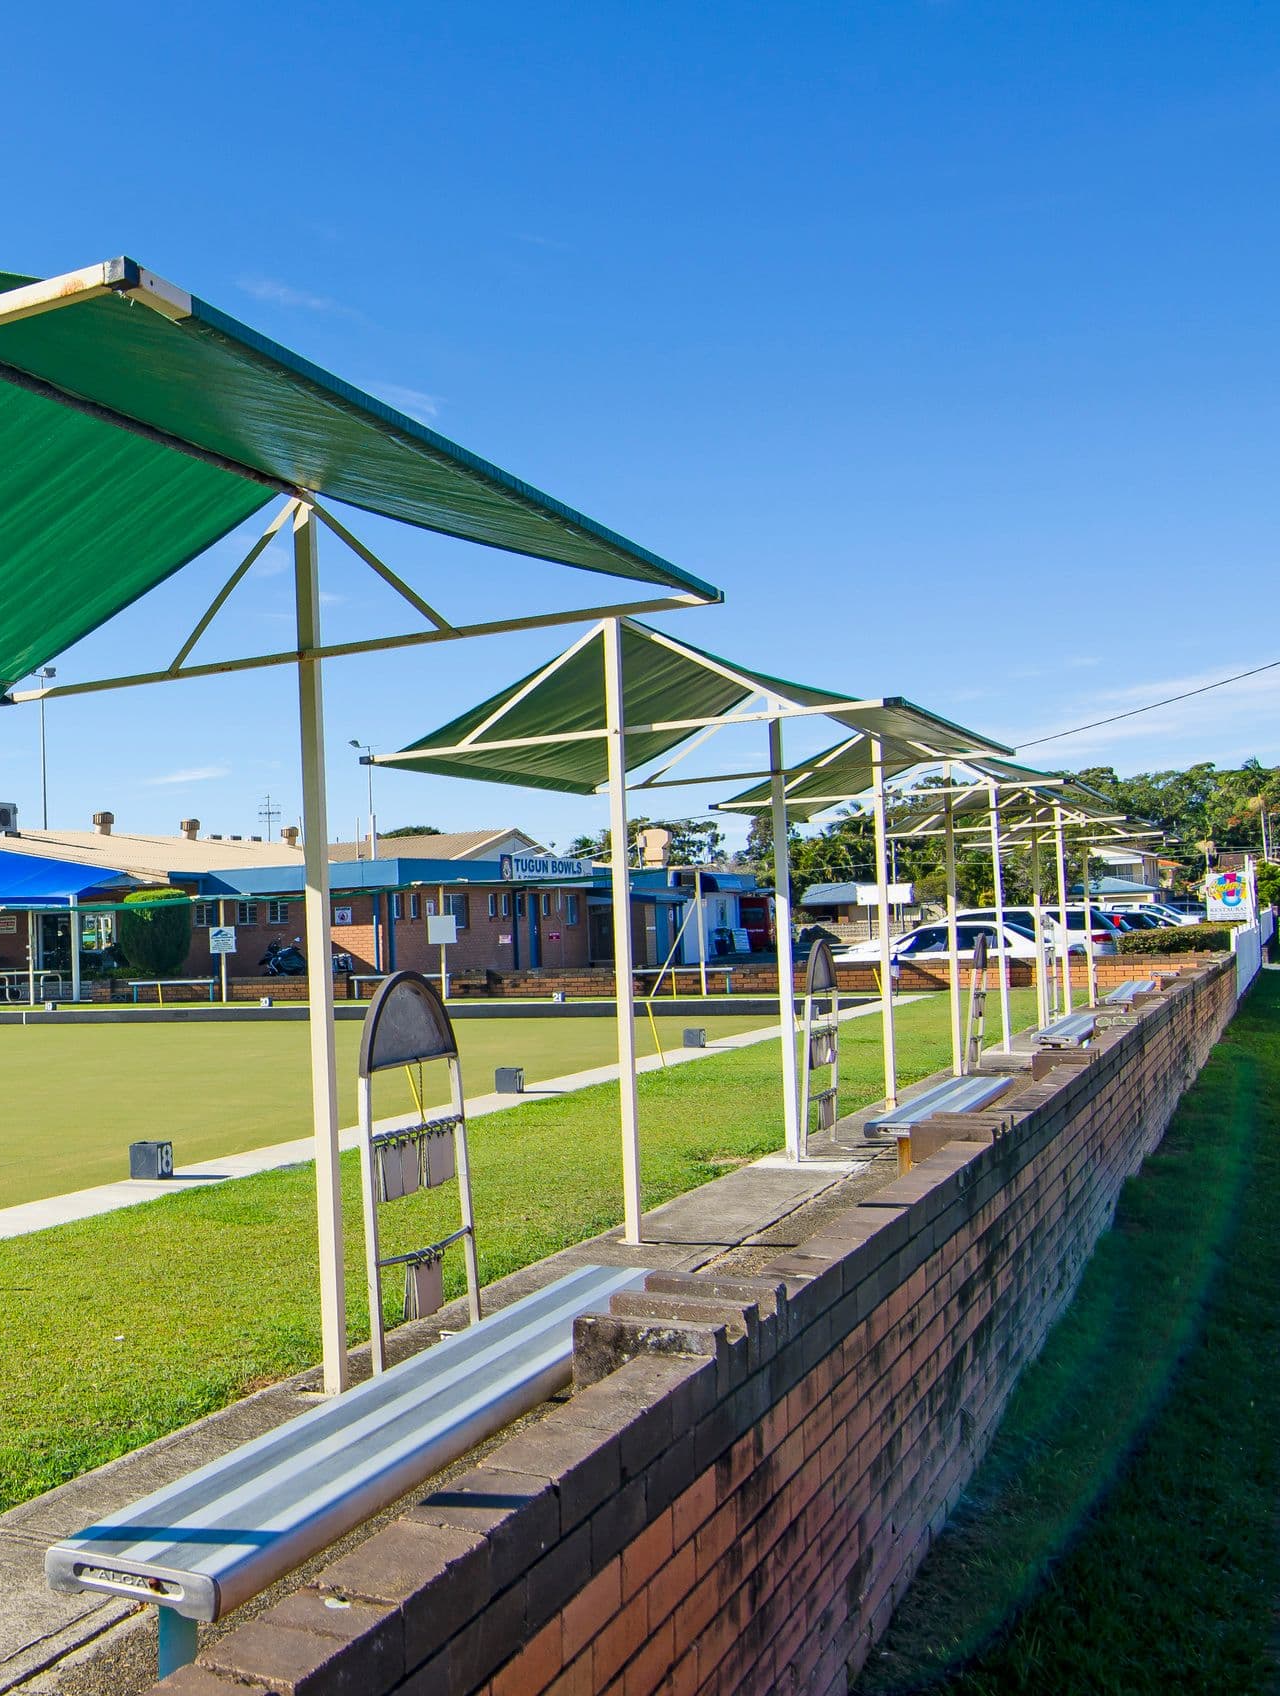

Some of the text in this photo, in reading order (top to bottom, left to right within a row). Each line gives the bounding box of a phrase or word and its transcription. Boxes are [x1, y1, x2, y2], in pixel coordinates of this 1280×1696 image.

[514, 858, 583, 875] TUGUN BOWLS
[157, 1144, 173, 1175] 18
